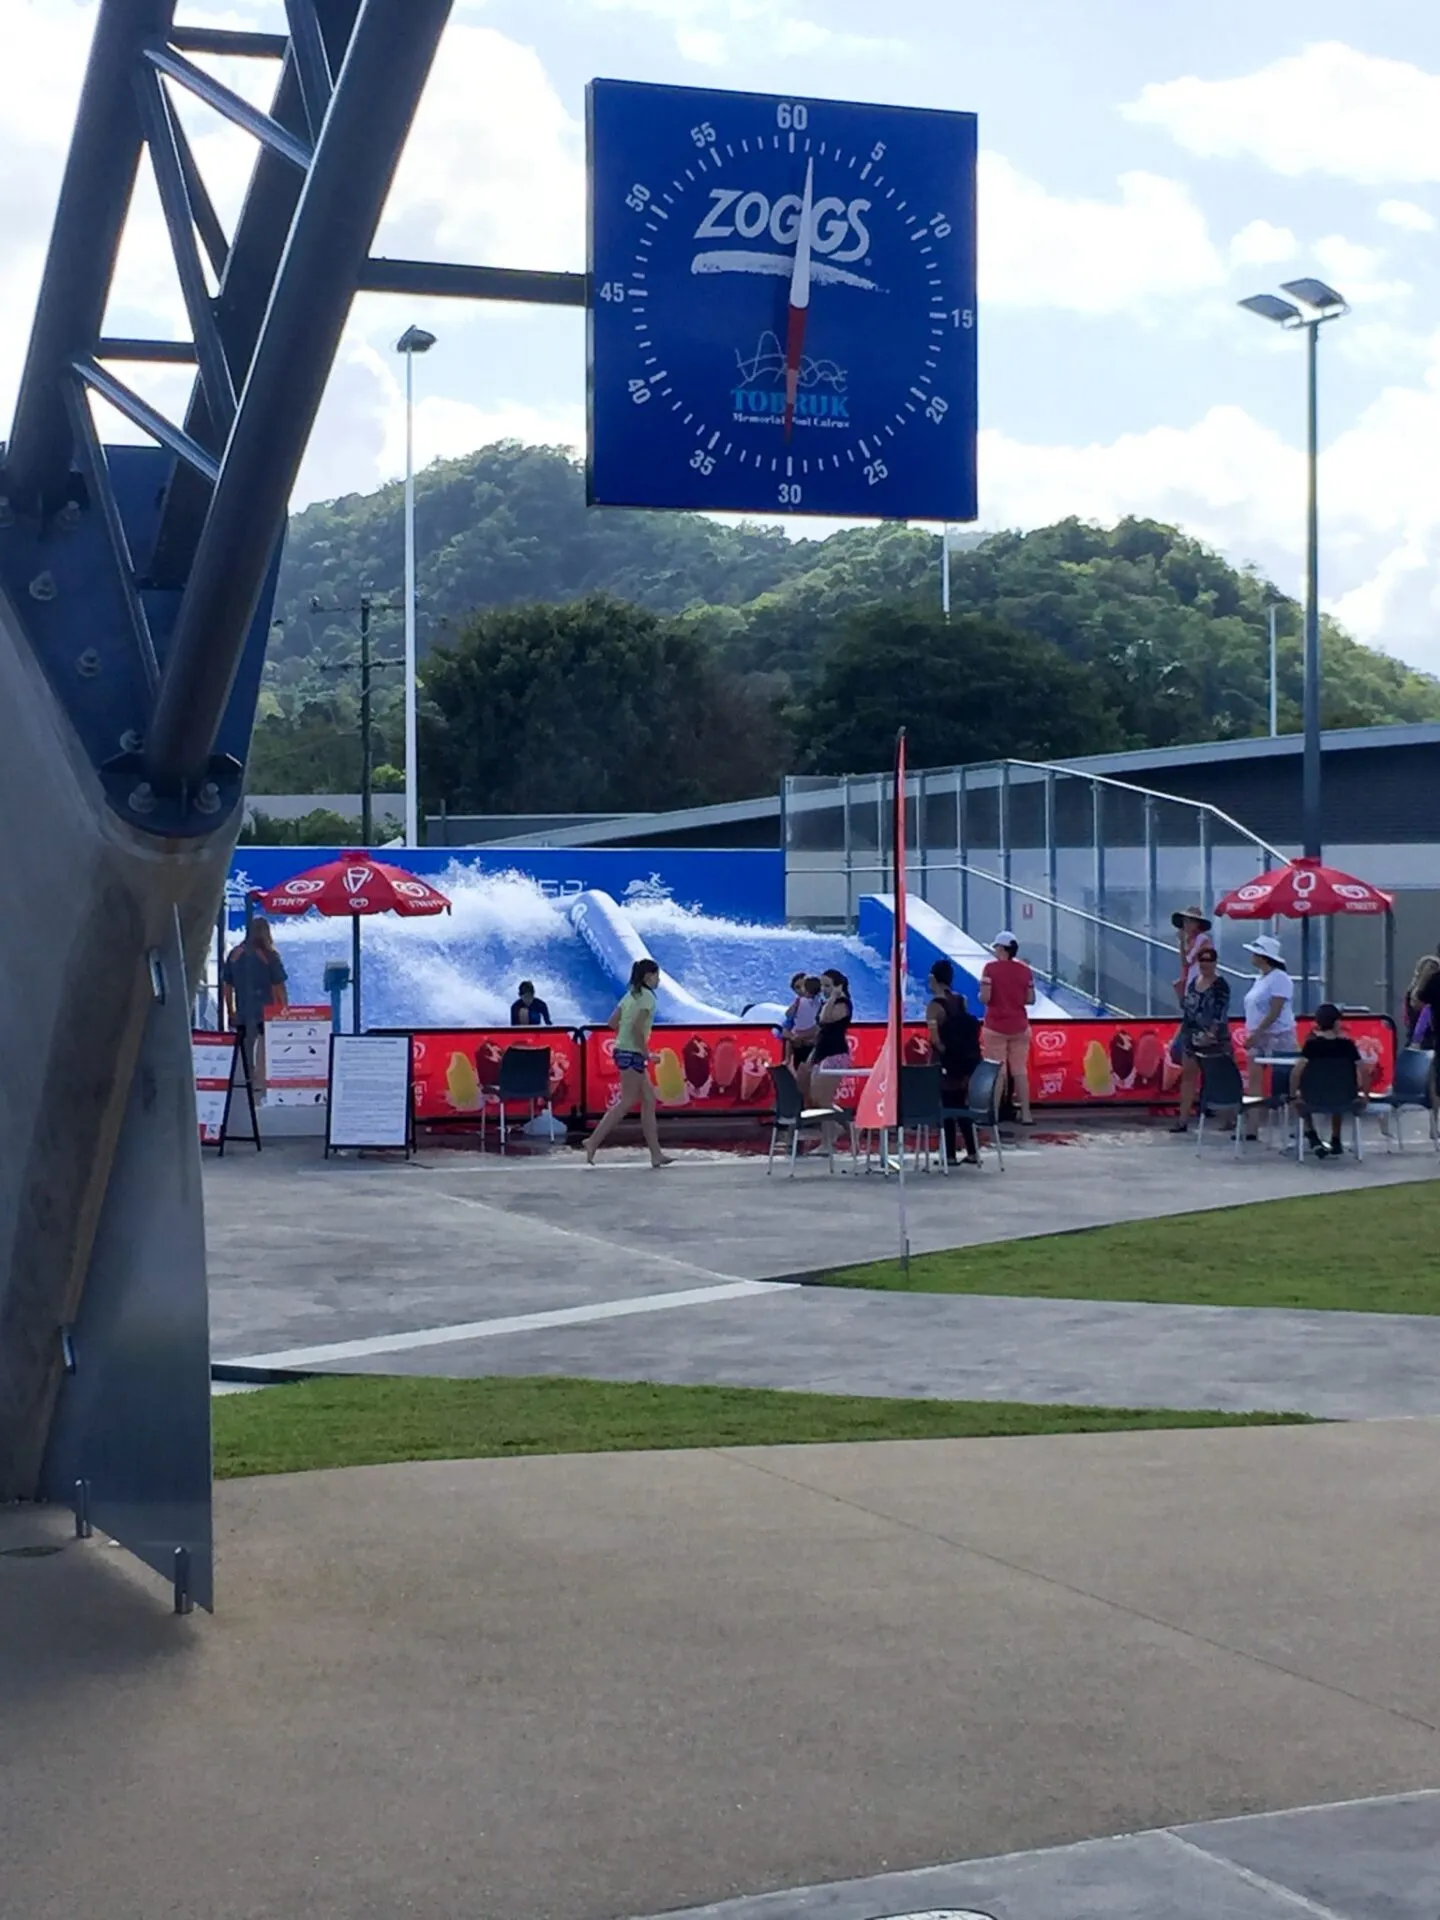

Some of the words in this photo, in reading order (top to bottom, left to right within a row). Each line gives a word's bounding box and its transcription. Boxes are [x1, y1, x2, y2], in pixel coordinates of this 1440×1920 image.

[777, 103, 807, 130] 60
[691, 122, 716, 148] 55
[871, 141, 886, 161] 5
[626, 185, 650, 212] 50
[693, 188, 872, 262] ZOGGS
[930, 213, 951, 239] 10
[599, 281, 624, 302] 45
[950, 309, 973, 329] 15
[627, 377, 652, 404] 40
[731, 388, 850, 418] TOBRUK
[925, 397, 949, 424] 20
[689, 449, 716, 475] 35
[864, 460, 888, 485] 25
[778, 483, 802, 504] 30
